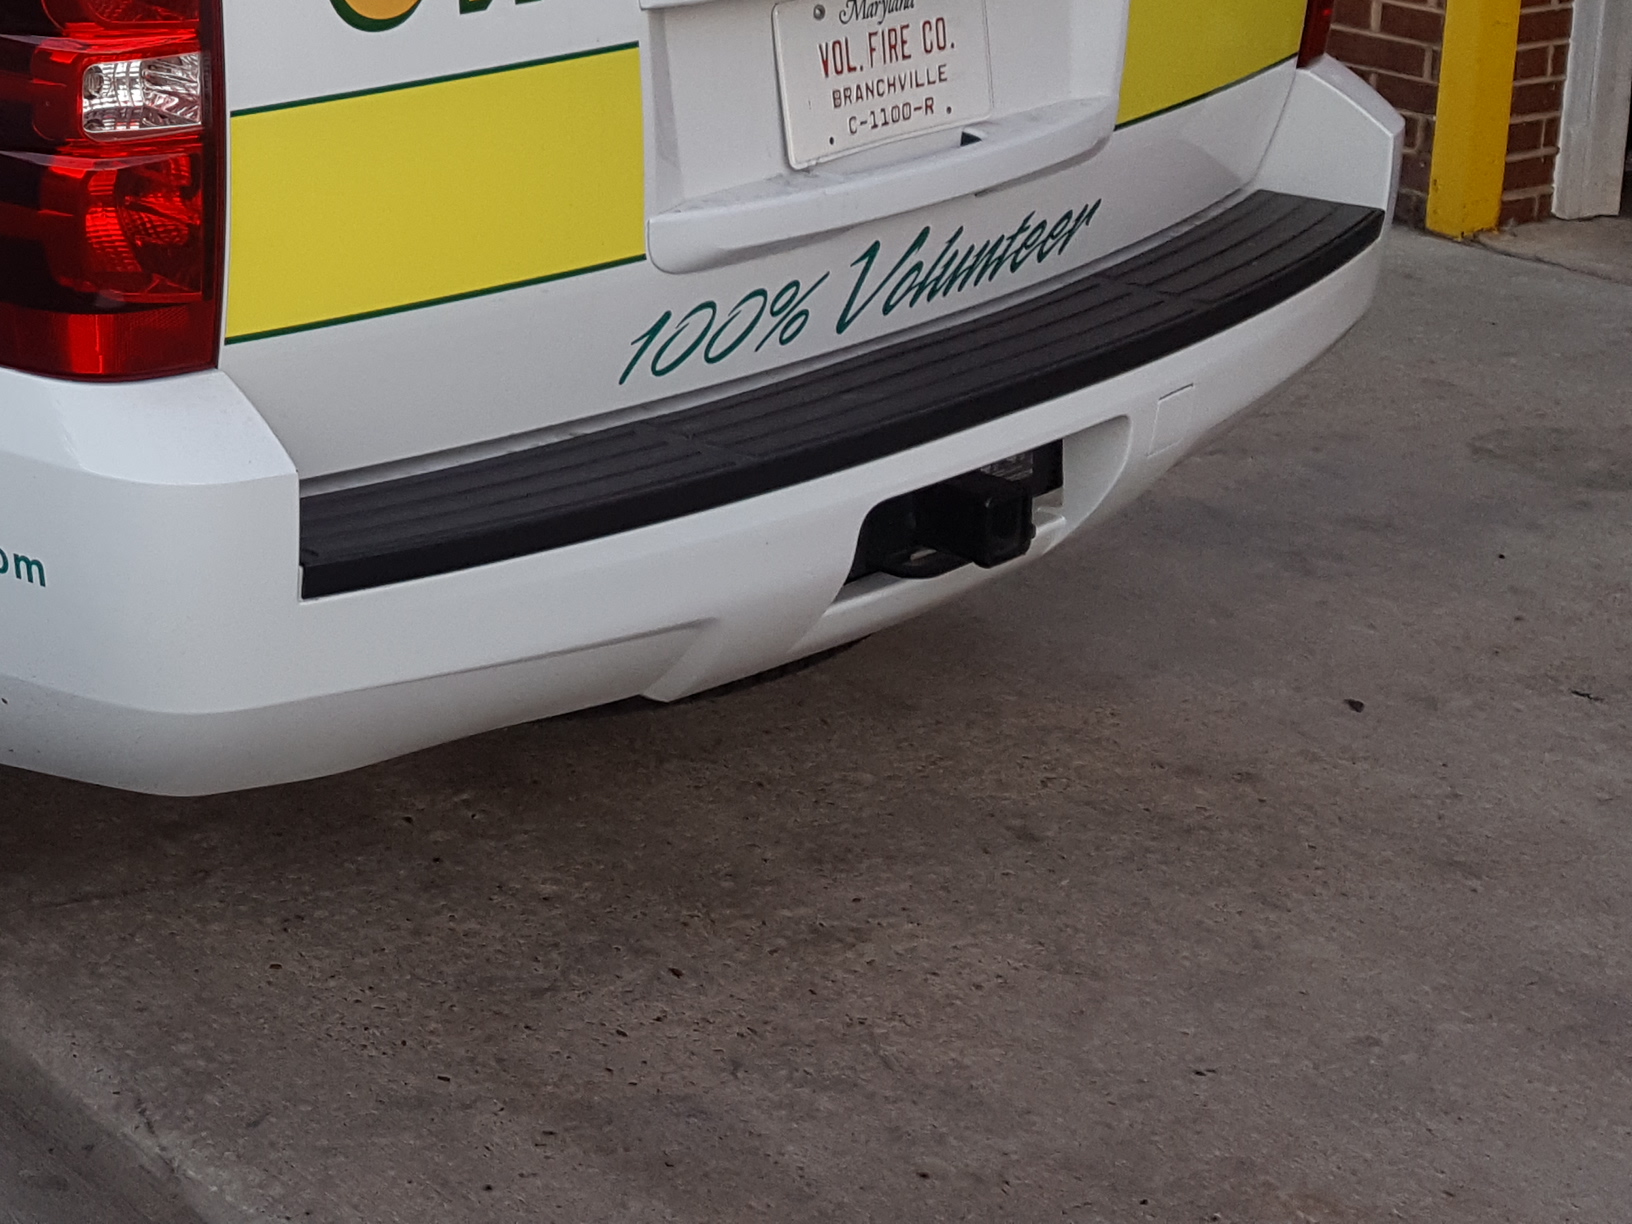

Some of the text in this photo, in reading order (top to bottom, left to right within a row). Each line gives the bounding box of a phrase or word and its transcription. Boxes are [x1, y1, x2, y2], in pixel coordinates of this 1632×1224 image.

[818, 17, 955, 78] VOL. FIRE CO.
[832, 64, 948, 109] BRANCHVILLE
[848, 97, 935, 135] C-1100-R
[619, 198, 1103, 386] 100% Volunteer
